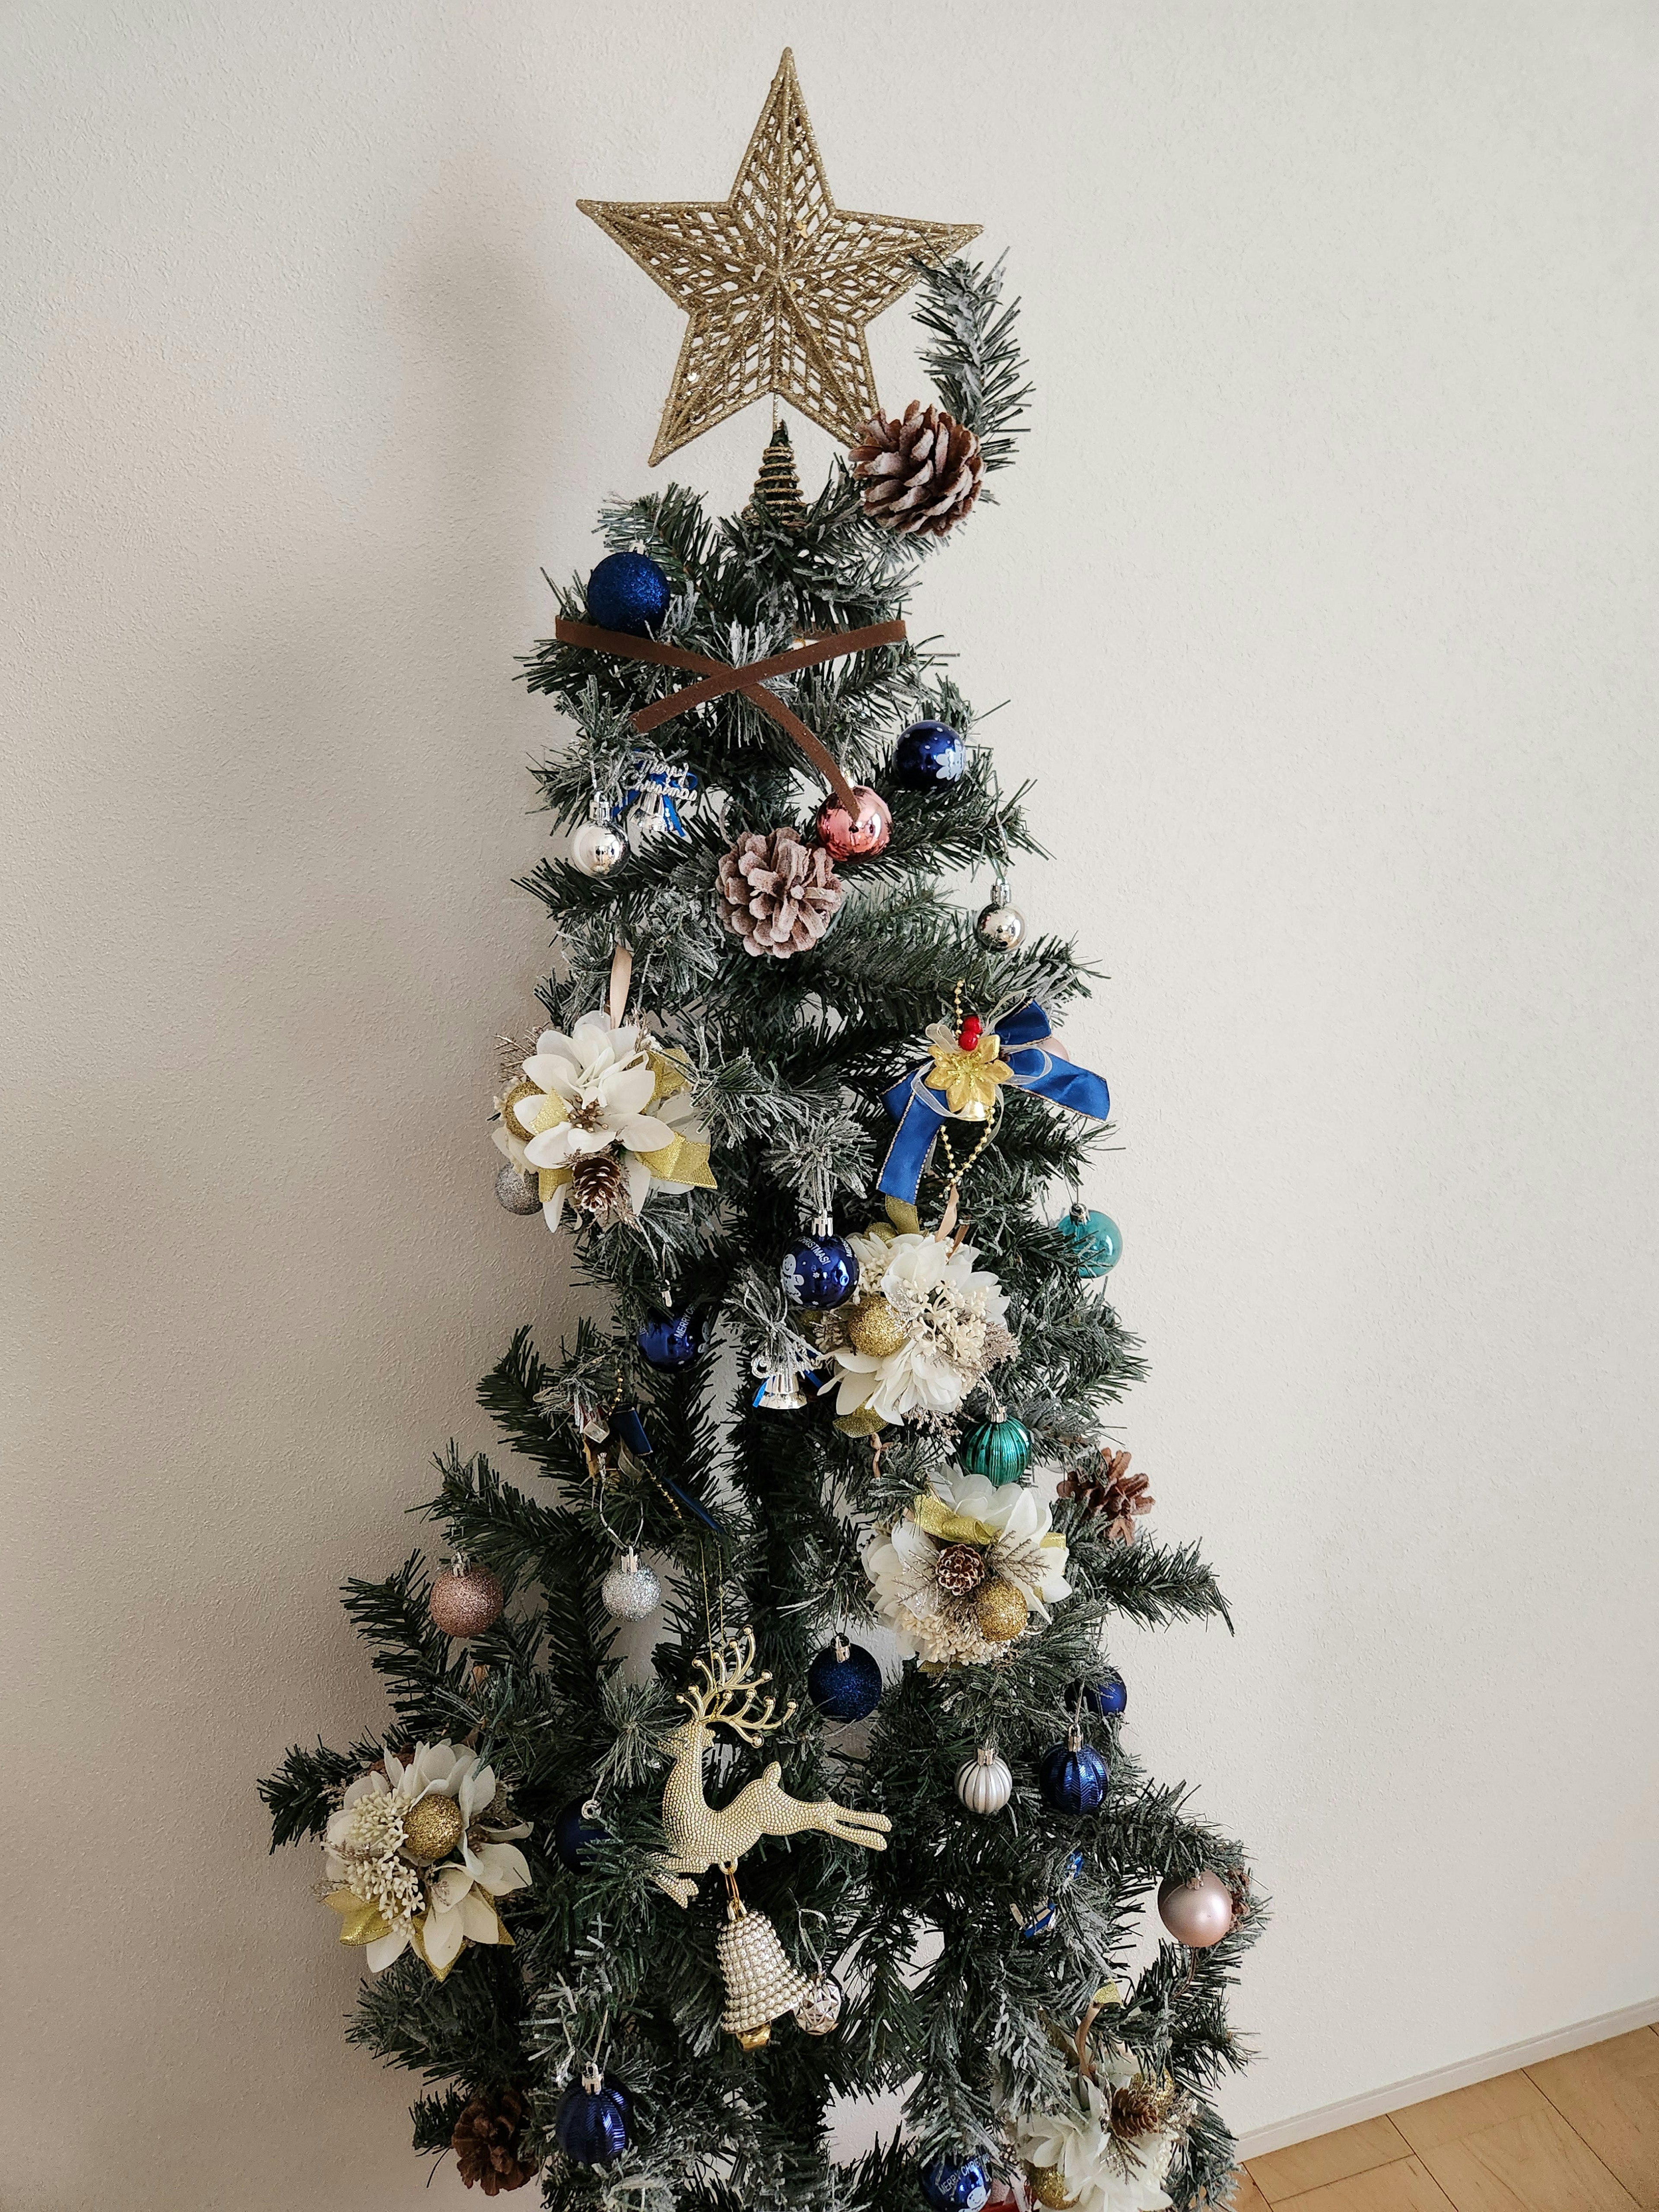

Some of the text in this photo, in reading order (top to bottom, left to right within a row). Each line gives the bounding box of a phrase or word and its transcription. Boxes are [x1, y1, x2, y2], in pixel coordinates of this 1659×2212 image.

[619, 769, 698, 801] Christmas
[633, 754, 689, 788] Merry
[674, 1313, 691, 1338] MERRY
